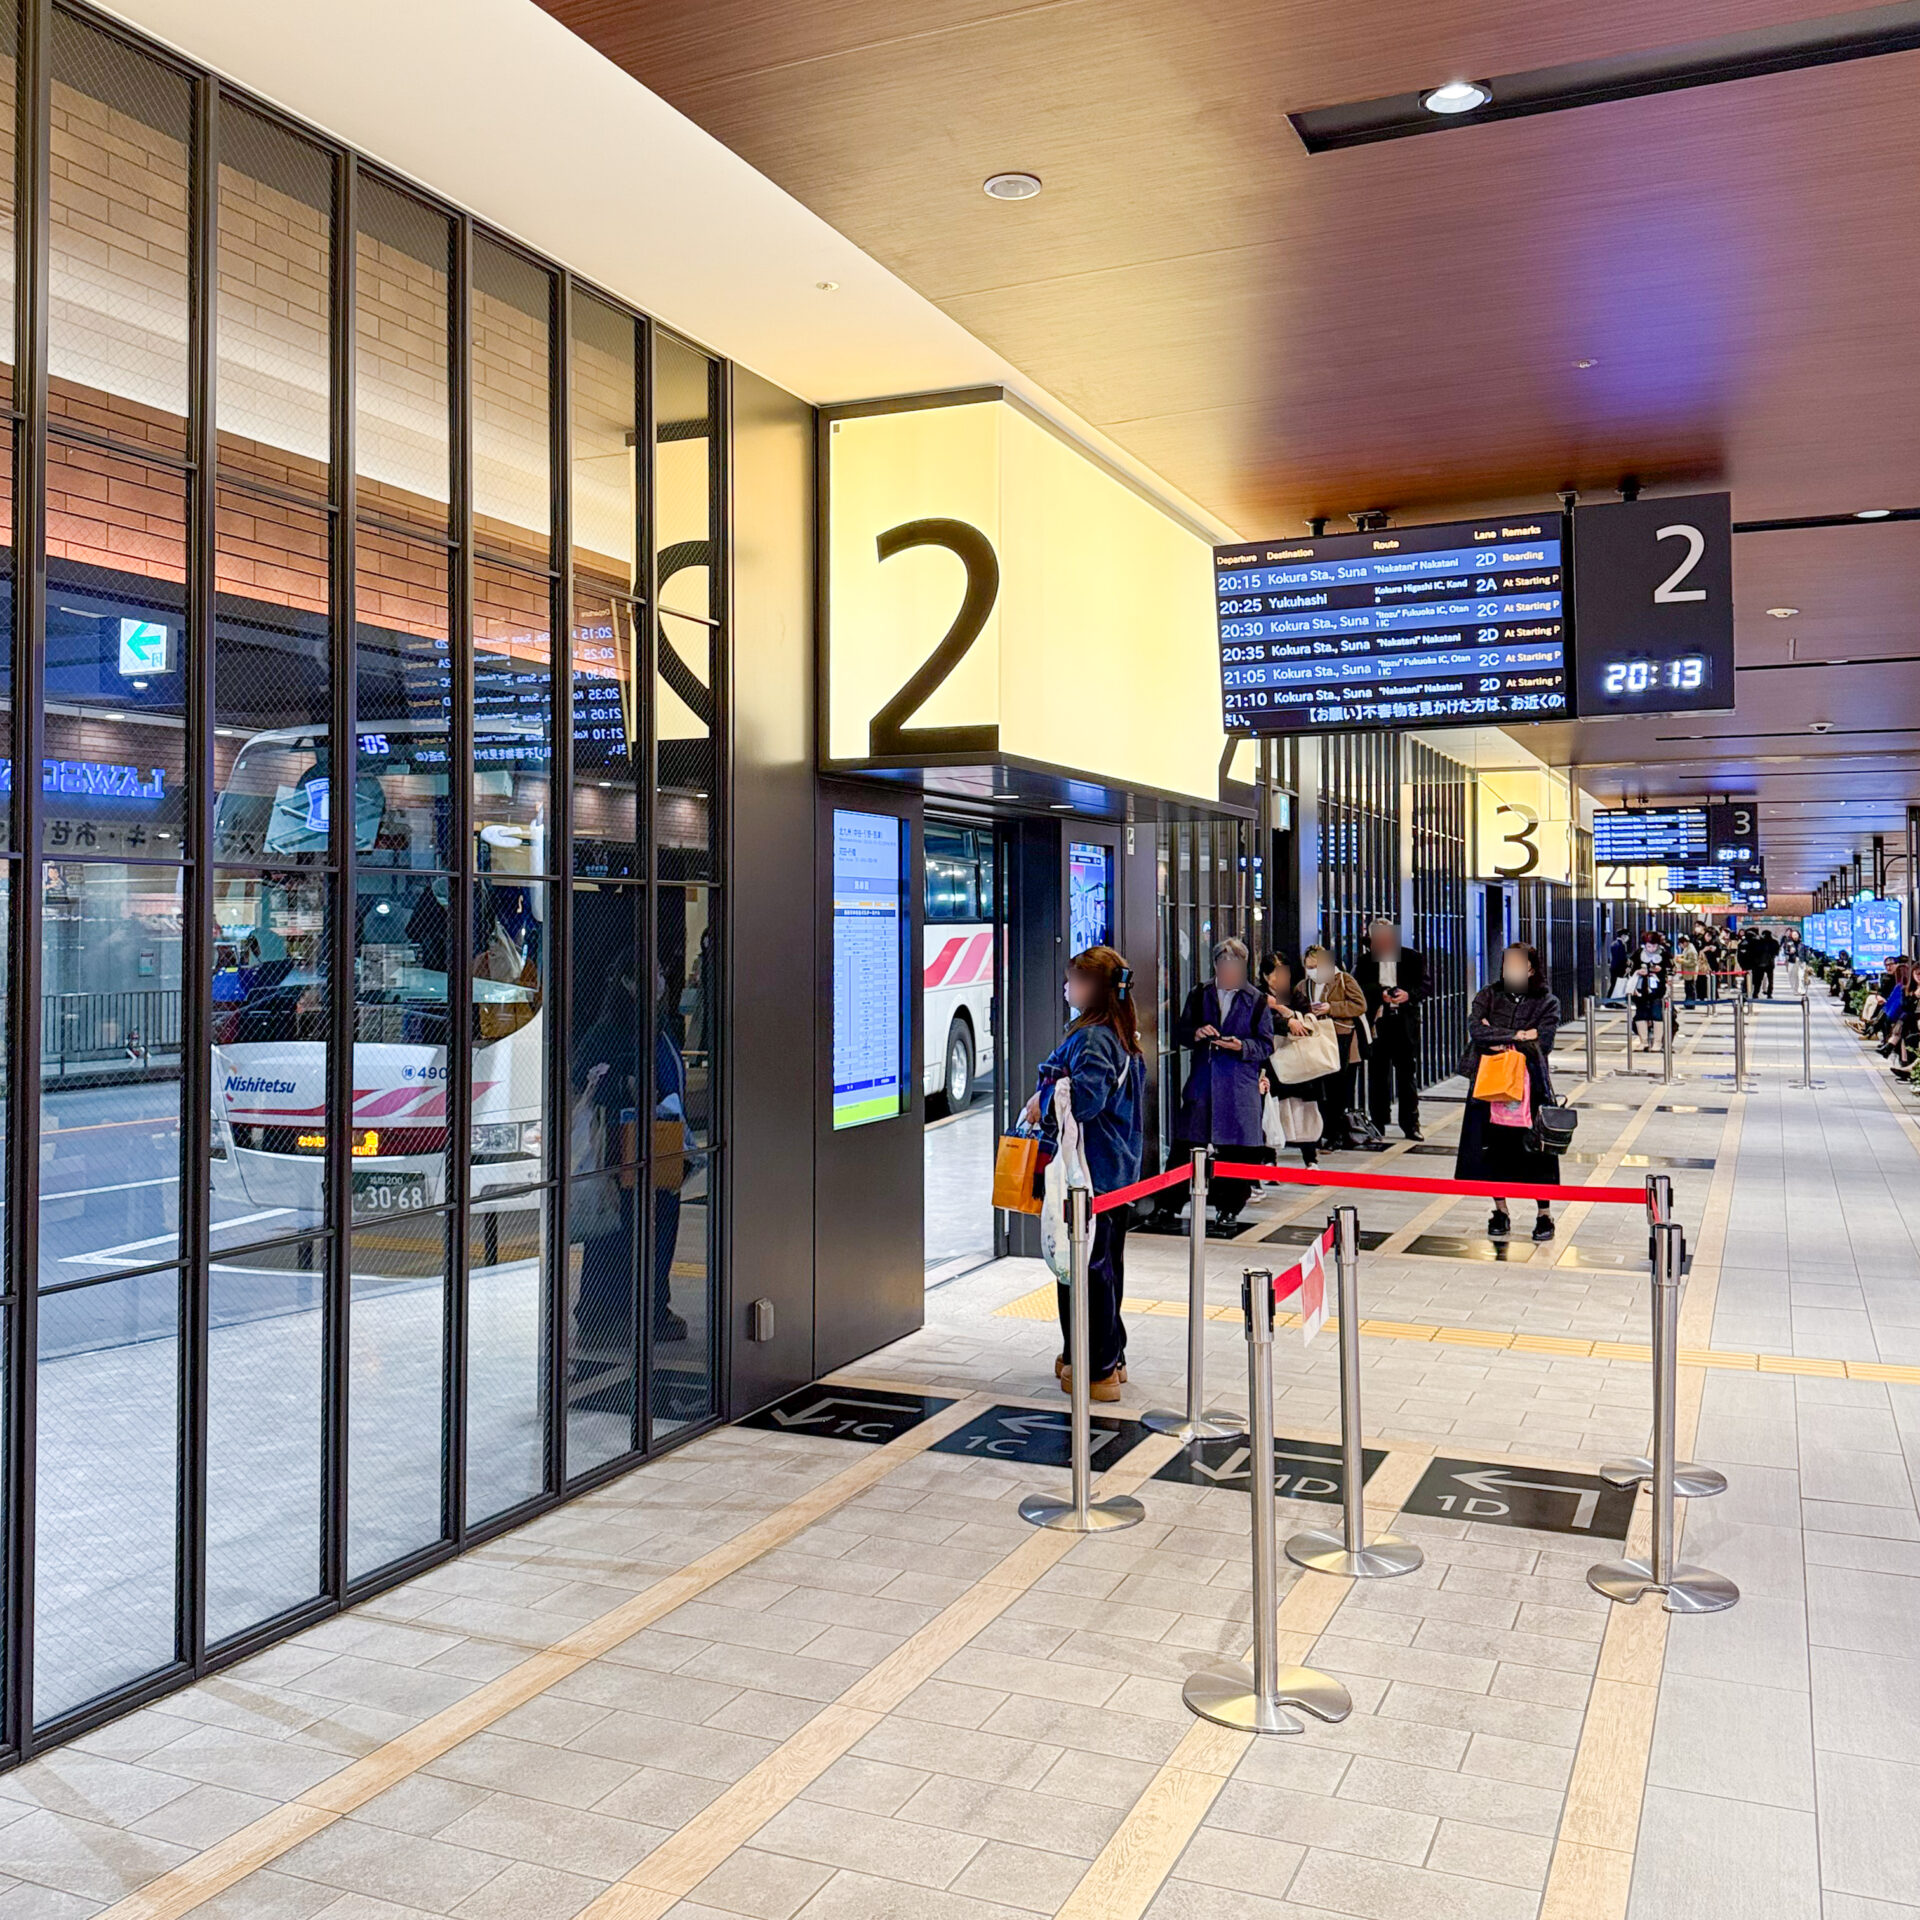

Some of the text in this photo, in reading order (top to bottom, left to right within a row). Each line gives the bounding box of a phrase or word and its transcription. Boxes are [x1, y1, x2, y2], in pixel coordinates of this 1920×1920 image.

[1217, 525, 1541, 565] Departure Destination Route Lane Remarks
[1218, 575, 1261, 591] 20:15
[1268, 572, 1307, 585] Kokura
[1310, 570, 1335, 581] Sta.,
[1338, 567, 1367, 579] Suna
[1420, 558, 1458, 570] Nakatani
[1476, 553, 1496, 567] 2D
[1502, 550, 1544, 562] Boarding
[1654, 524, 1707, 604] 2
[1220, 599, 1262, 615] 20:25
[1269, 594, 1327, 609] Yukuhashi
[1375, 586, 1402, 595] Kokura
[1403, 582, 1433, 593] Higashi
[1476, 578, 1497, 592] 2A
[1503, 578, 1514, 587] At
[1515, 576, 1550, 587] Starting
[1552, 575, 1559, 583] P
[1221, 622, 1263, 638] 20:30
[1271, 621, 1310, 633] Kokura
[1312, 619, 1337, 630] Sta.,
[1340, 616, 1369, 627] Suna
[1402, 607, 1435, 617] Fukuoka
[1449, 605, 1469, 613] Otan
[1477, 604, 1498, 617] 2C
[1504, 603, 1514, 613] At
[1516, 601, 1551, 612] Starting
[1553, 600, 1559, 608] P
[868, 517, 999, 757] 2
[1223, 646, 1265, 662] 20:35
[1272, 644, 1311, 656] Kokura
[1313, 643, 1338, 654] Sta.,
[1341, 640, 1370, 651] Suna
[1422, 633, 1461, 644] Nakatani
[1478, 628, 1499, 643] 2D
[1504, 629, 1515, 638] At
[1516, 627, 1551, 637] Starting
[1554, 626, 1560, 634] P
[1224, 670, 1266, 685] 21:05
[1273, 668, 1312, 680] Kokura
[1314, 666, 1339, 677] Sta.,
[1342, 664, 1371, 675] Suna
[1404, 657, 1436, 666] Fukuoka
[1451, 654, 1470, 663] Otan
[1479, 653, 1500, 667] 2C
[1505, 654, 1516, 663] At
[1517, 652, 1552, 662] Starting
[1554, 651, 1561, 659] P
[1606, 658, 1703, 693] 20:13
[1225, 693, 1267, 708] 21:10
[1274, 692, 1313, 704] Kokura
[1316, 690, 1340, 701] Sta.,
[1343, 688, 1372, 699] Suna
[1424, 682, 1463, 692] Nakatani
[1480, 678, 1500, 691] 2D
[1506, 679, 1516, 688] At
[1518, 677, 1553, 686] Starting
[1555, 676, 1562, 684] P
[1310, 694, 1566, 723] 【お願い】不審物を見かけた方は、お近くの
[1734, 811, 1751, 835] 3
[1494, 804, 1539, 877] 3
[224, 1076, 296, 1094] Nishitetsu
[367, 1187, 422, 1209] 30-68
[833, 1420, 894, 1438] 1C
[965, 1436, 1028, 1455] 1C
[1436, 1495, 1510, 1517] 1D
